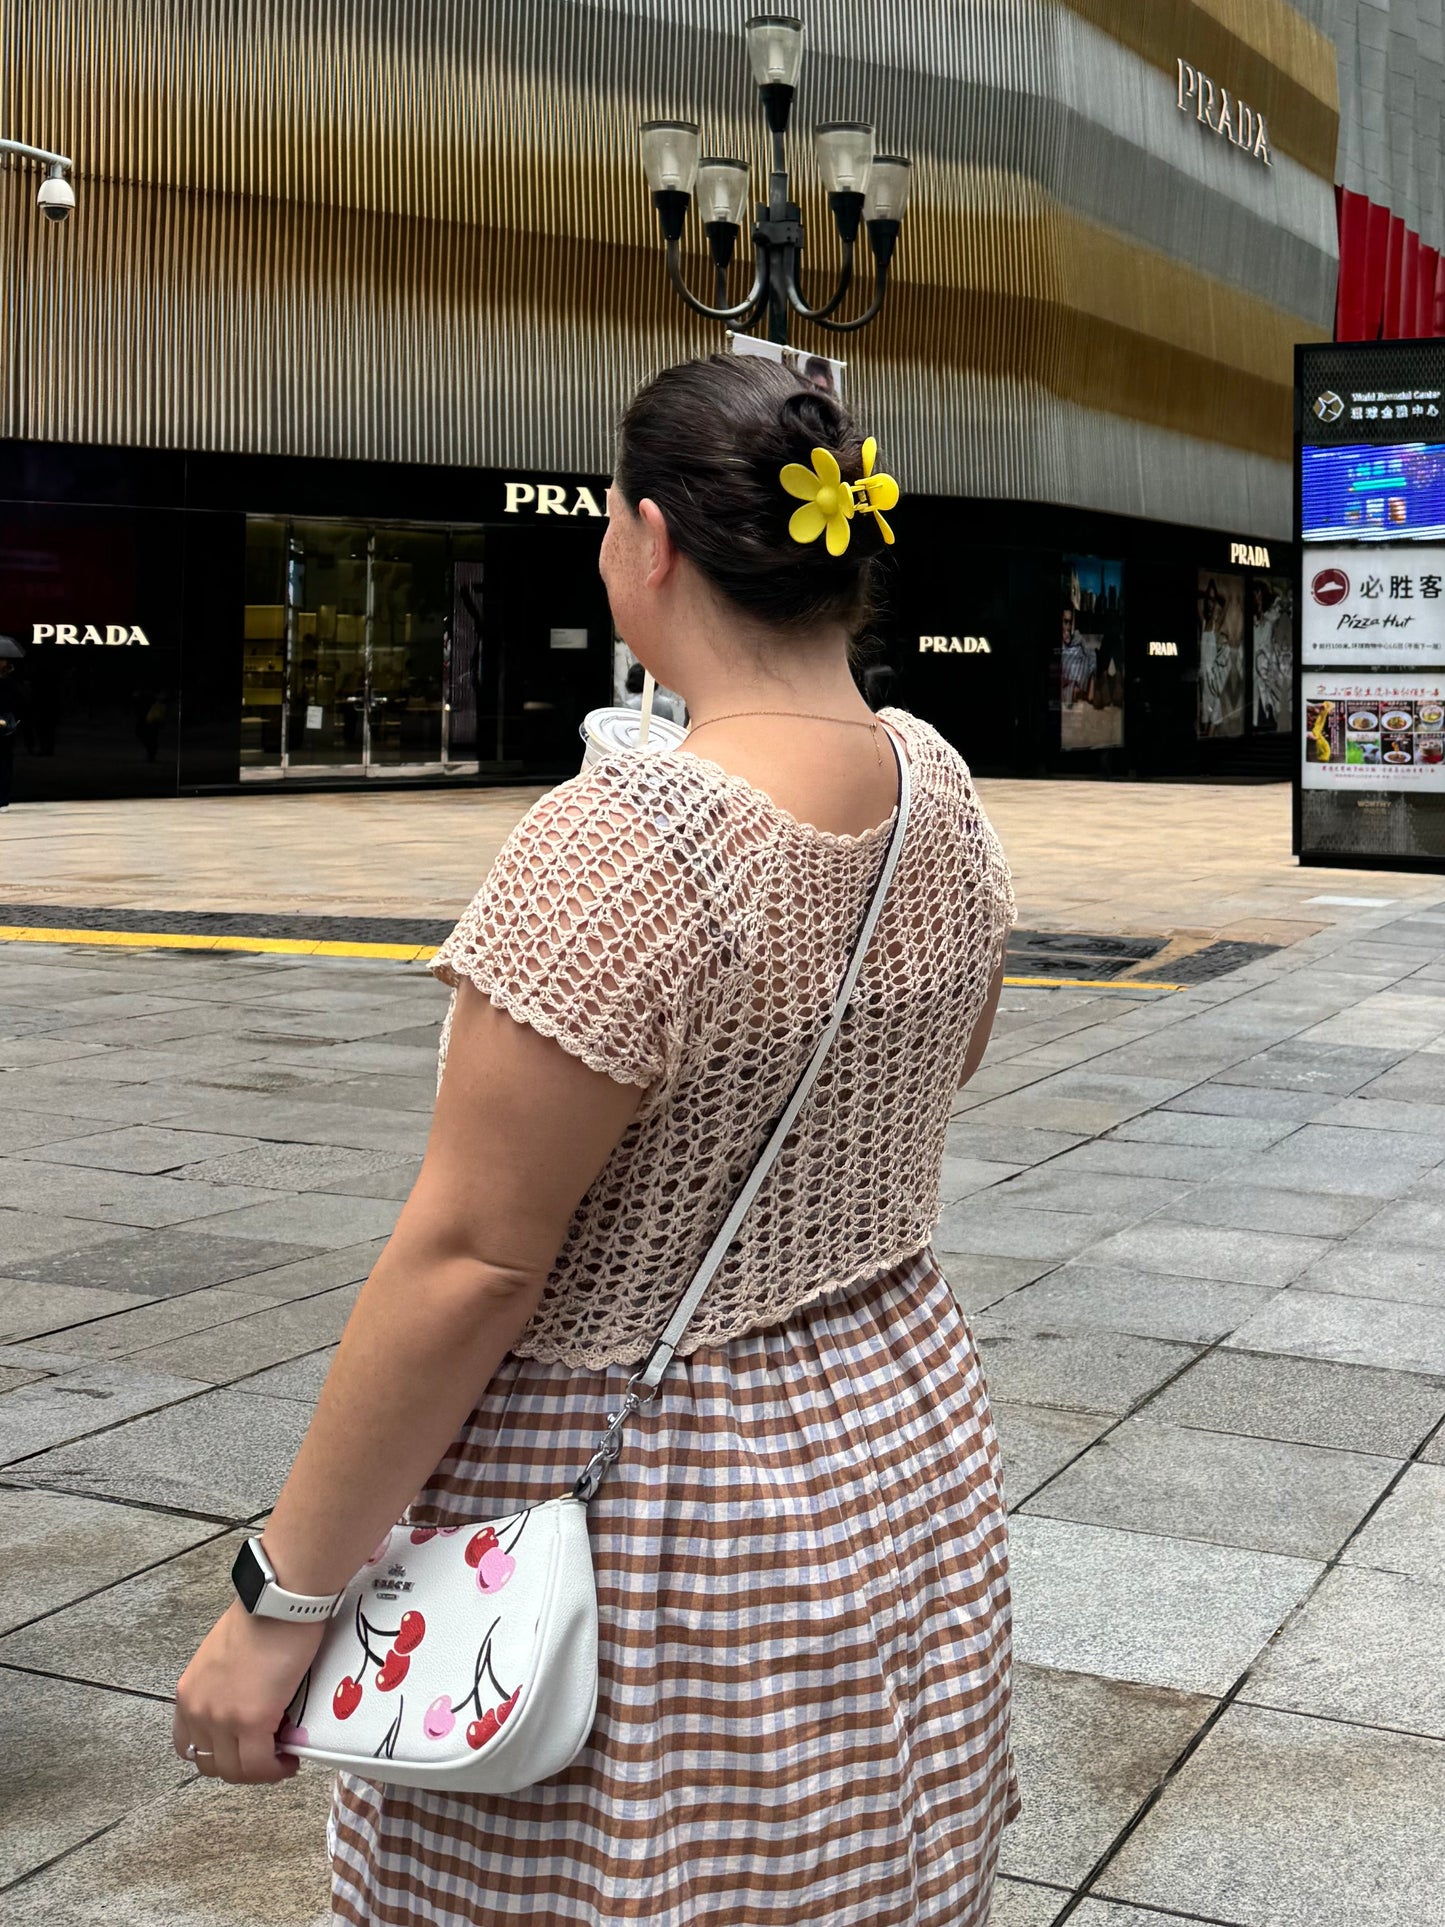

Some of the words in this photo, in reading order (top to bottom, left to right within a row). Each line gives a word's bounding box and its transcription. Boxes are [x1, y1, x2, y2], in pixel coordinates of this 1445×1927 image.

[1177, 58, 1272, 166] PRADA
[1351, 392, 1375, 402] World
[1413, 390, 1441, 400] Center
[504, 482, 611, 517] PRA
[1230, 542, 1271, 568] PRADA
[1360, 574, 1443, 599] 必胜客
[1337, 614, 1380, 630] Pizza
[1383, 614, 1415, 628] Hut
[31, 623, 150, 646] PRADA
[919, 635, 992, 654] PRADA
[1148, 641, 1178, 656] PRADA
